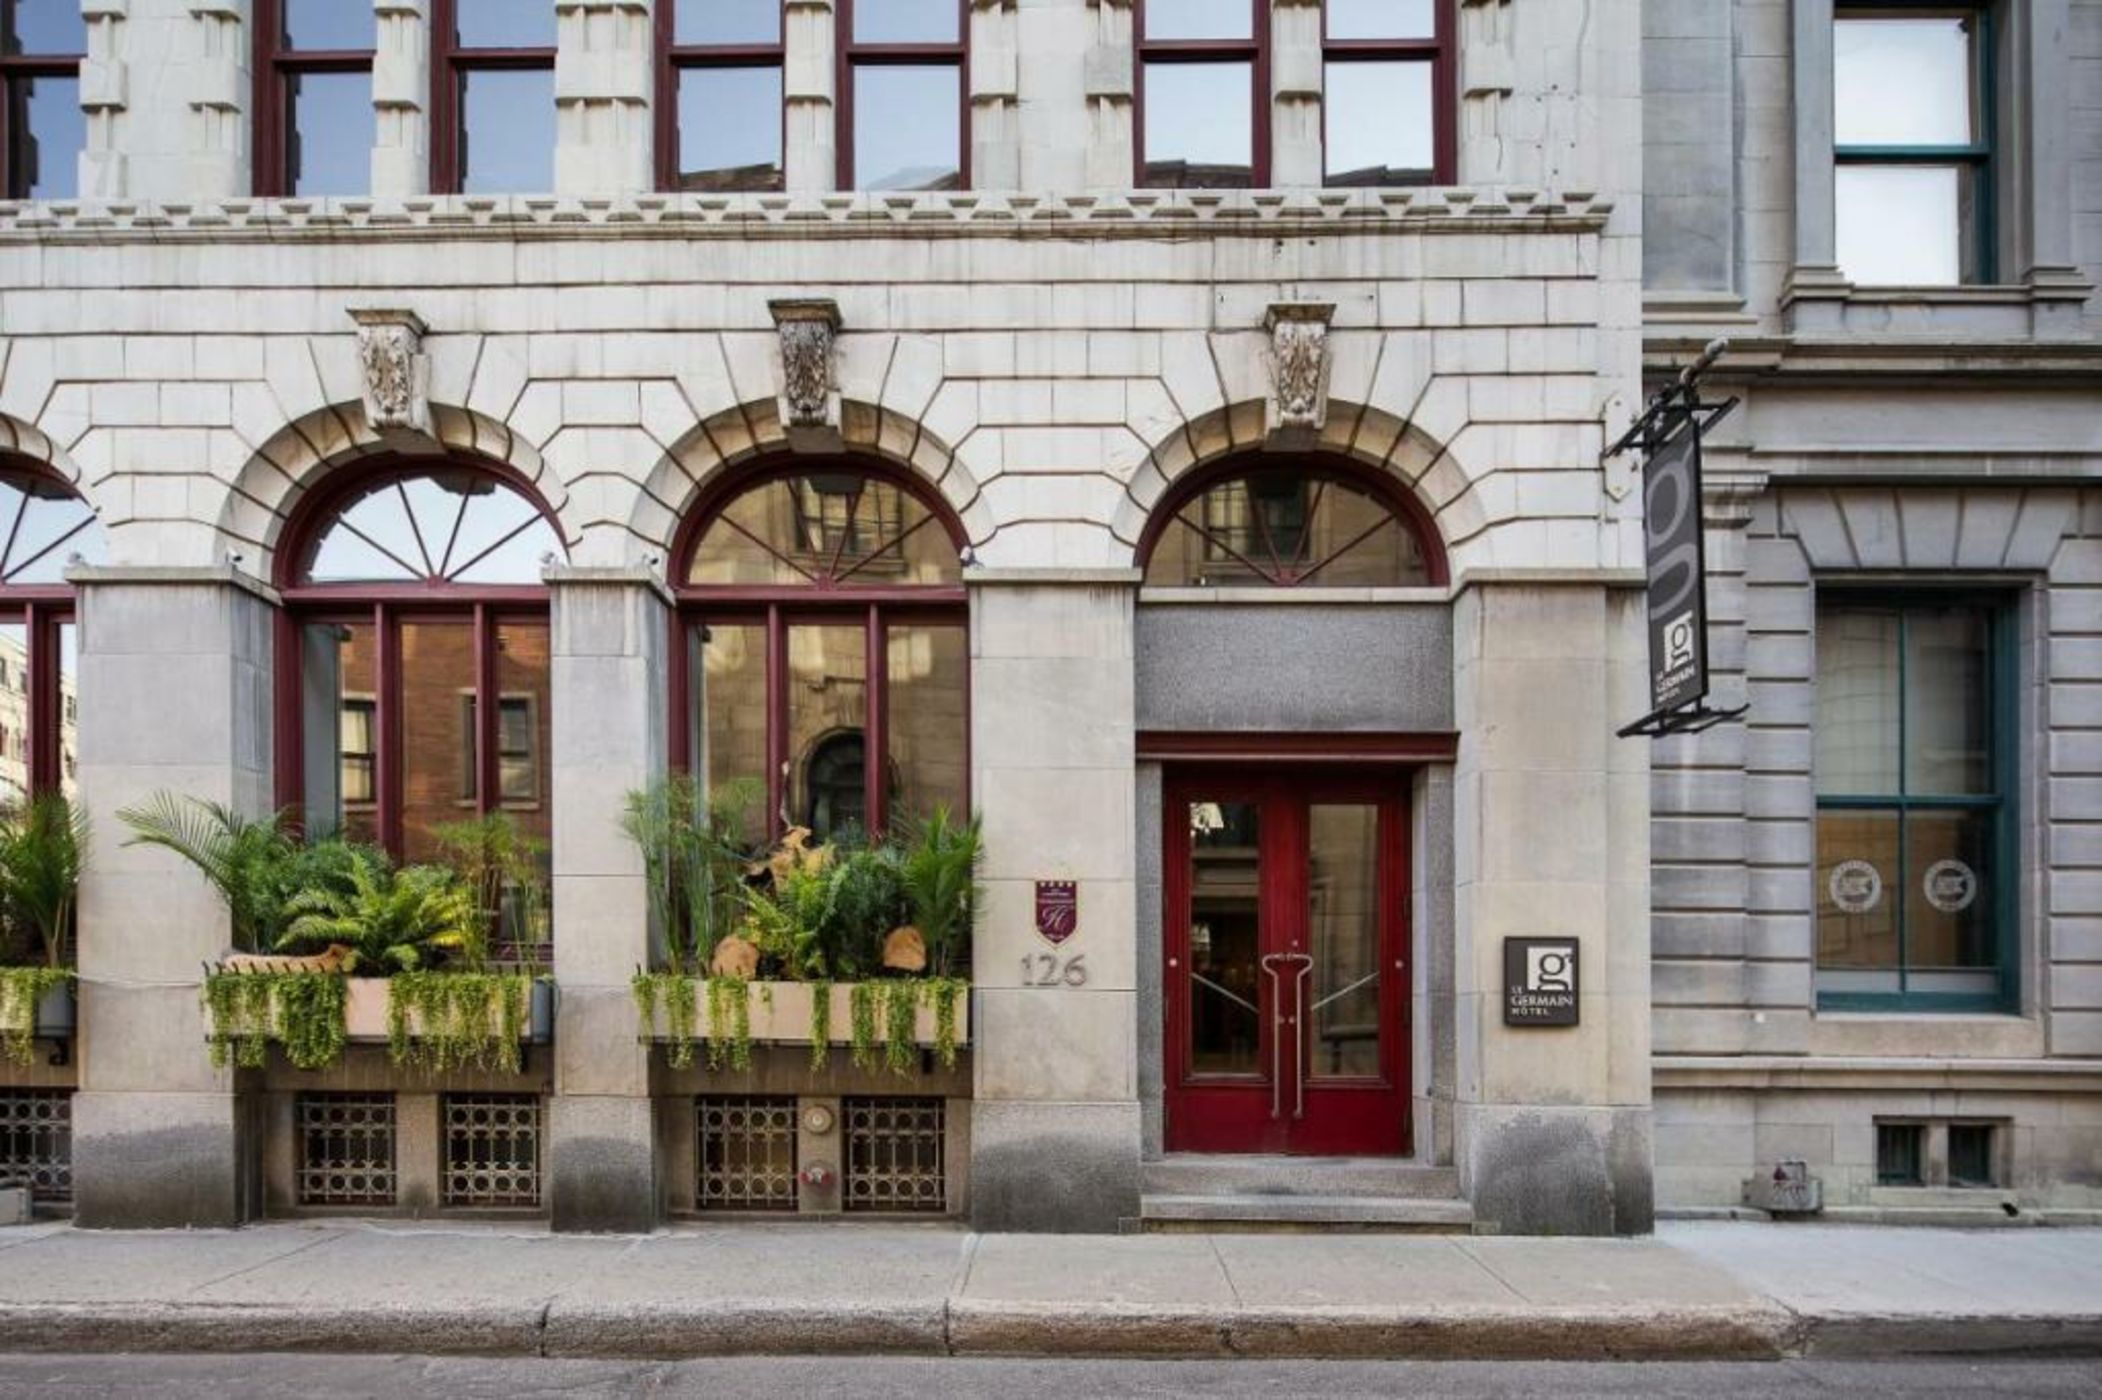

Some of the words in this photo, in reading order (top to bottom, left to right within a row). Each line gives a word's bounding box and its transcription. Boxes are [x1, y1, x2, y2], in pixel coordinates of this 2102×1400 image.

[1021, 953, 1087, 986] 126
[1538, 952, 1575, 992] g
[1510, 995, 1573, 1007] GERMAIN
